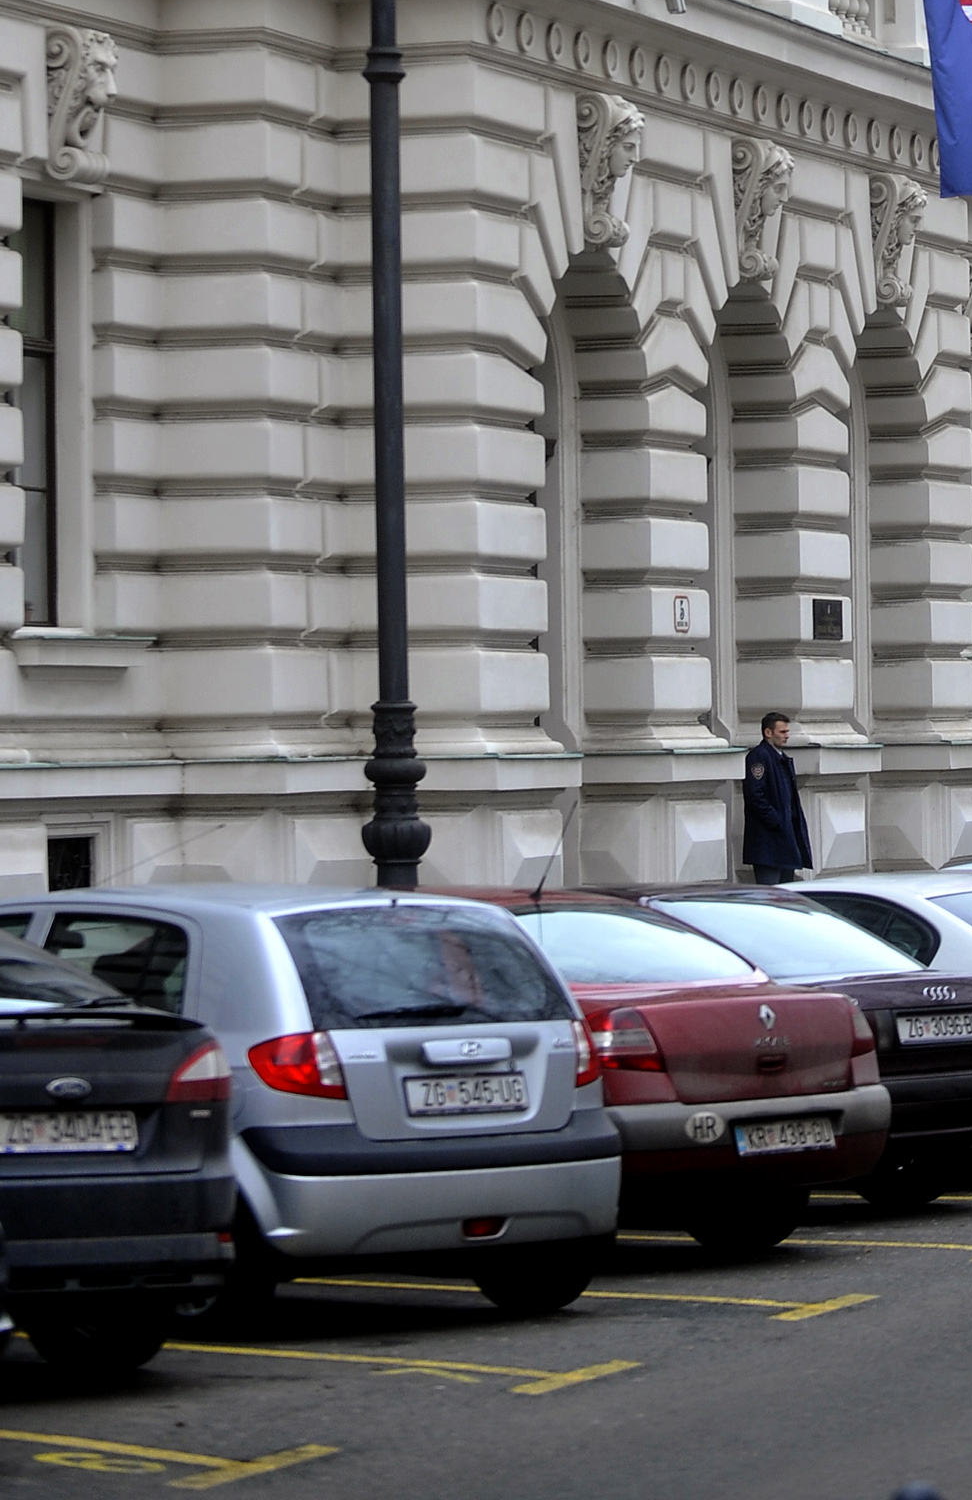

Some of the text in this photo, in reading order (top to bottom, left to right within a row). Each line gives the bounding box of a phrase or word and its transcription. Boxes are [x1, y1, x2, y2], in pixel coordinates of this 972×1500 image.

[905, 1018, 925, 1038] ZG
[421, 1077, 524, 1107] ZG 545-UG
[692, 1116, 718, 1139] HR
